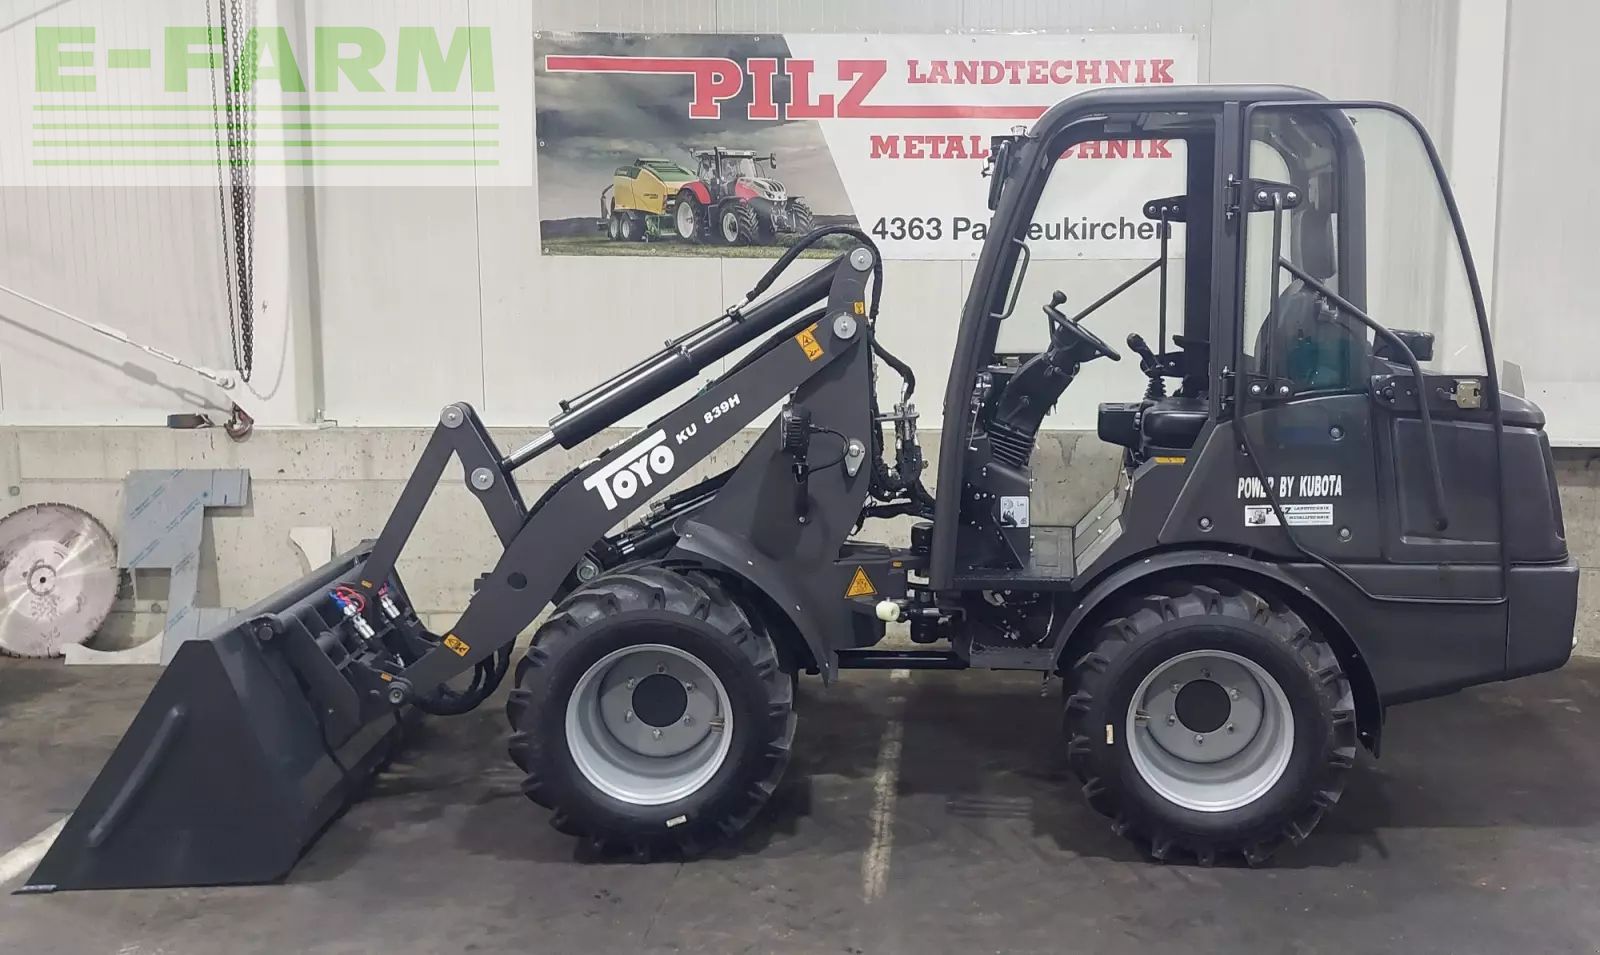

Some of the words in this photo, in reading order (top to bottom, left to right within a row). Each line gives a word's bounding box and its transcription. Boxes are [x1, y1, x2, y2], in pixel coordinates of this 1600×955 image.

[907, 59, 1175, 84] LANDTECHNIK
[689, 57, 887, 121] PILZ
[870, 135, 1172, 159] METALHNIK
[872, 217, 942, 240] 4363
[953, 216, 1172, 240] Paeukirchen
[583, 429, 675, 511] TOYO
[675, 423, 698, 445] KU
[703, 393, 741, 424] 839H
[1279, 476, 1295, 498] BY
[1299, 474, 1343, 497] KUBOTA
